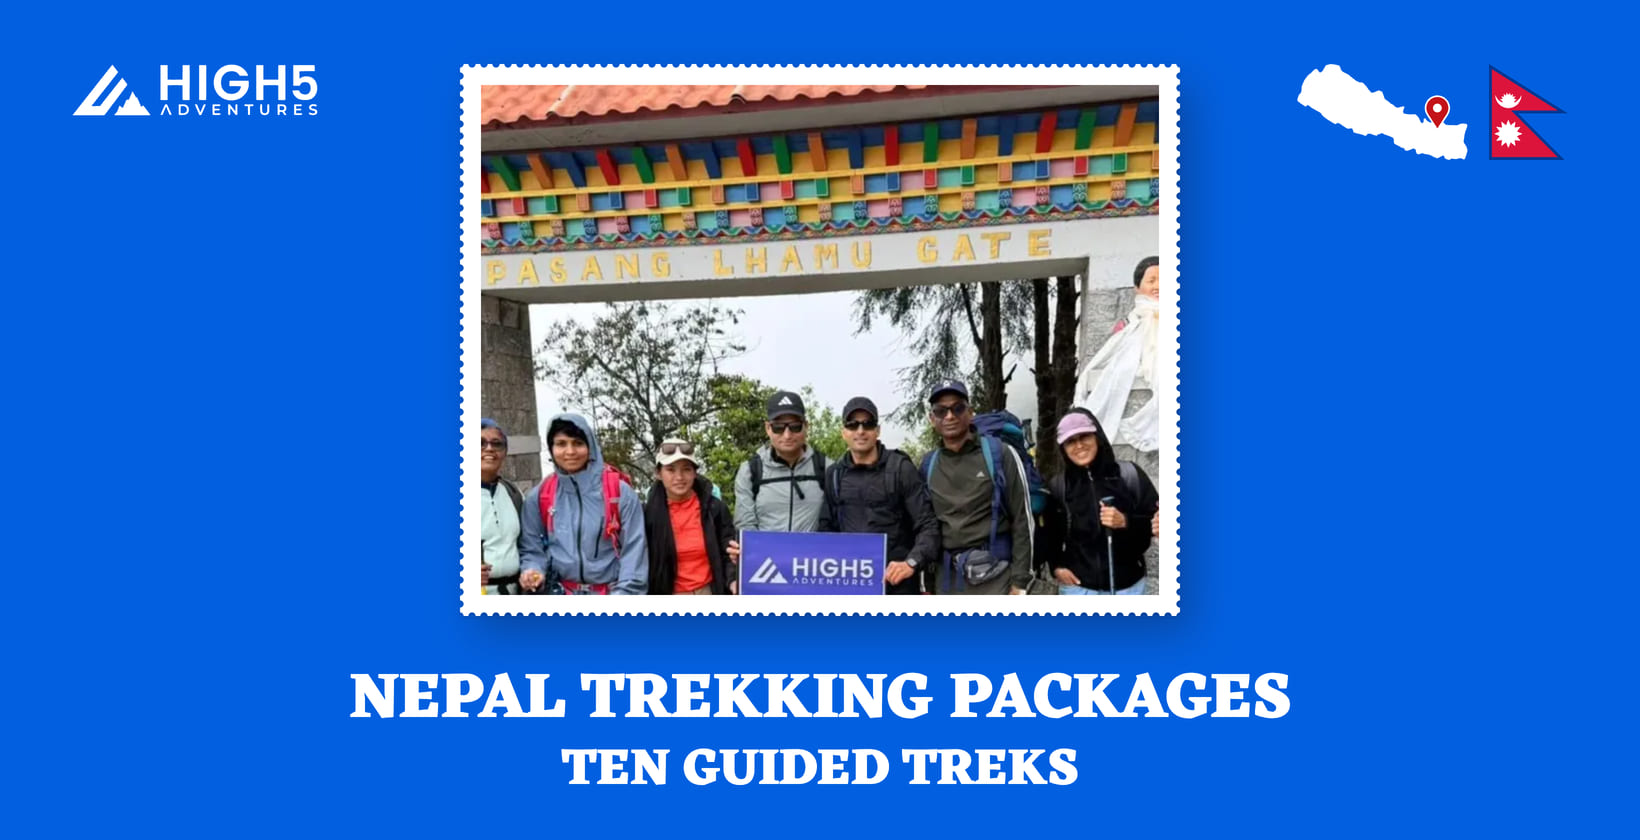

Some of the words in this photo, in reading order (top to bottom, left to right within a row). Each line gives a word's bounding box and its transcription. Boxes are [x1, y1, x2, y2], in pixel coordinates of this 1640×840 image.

[486, 251, 671, 286] PASANG
[712, 240, 872, 276] LHAMU
[916, 228, 1053, 264] GATE
[792, 557, 874, 579] HIGH5
[792, 577, 874, 586] ADVENTURES
